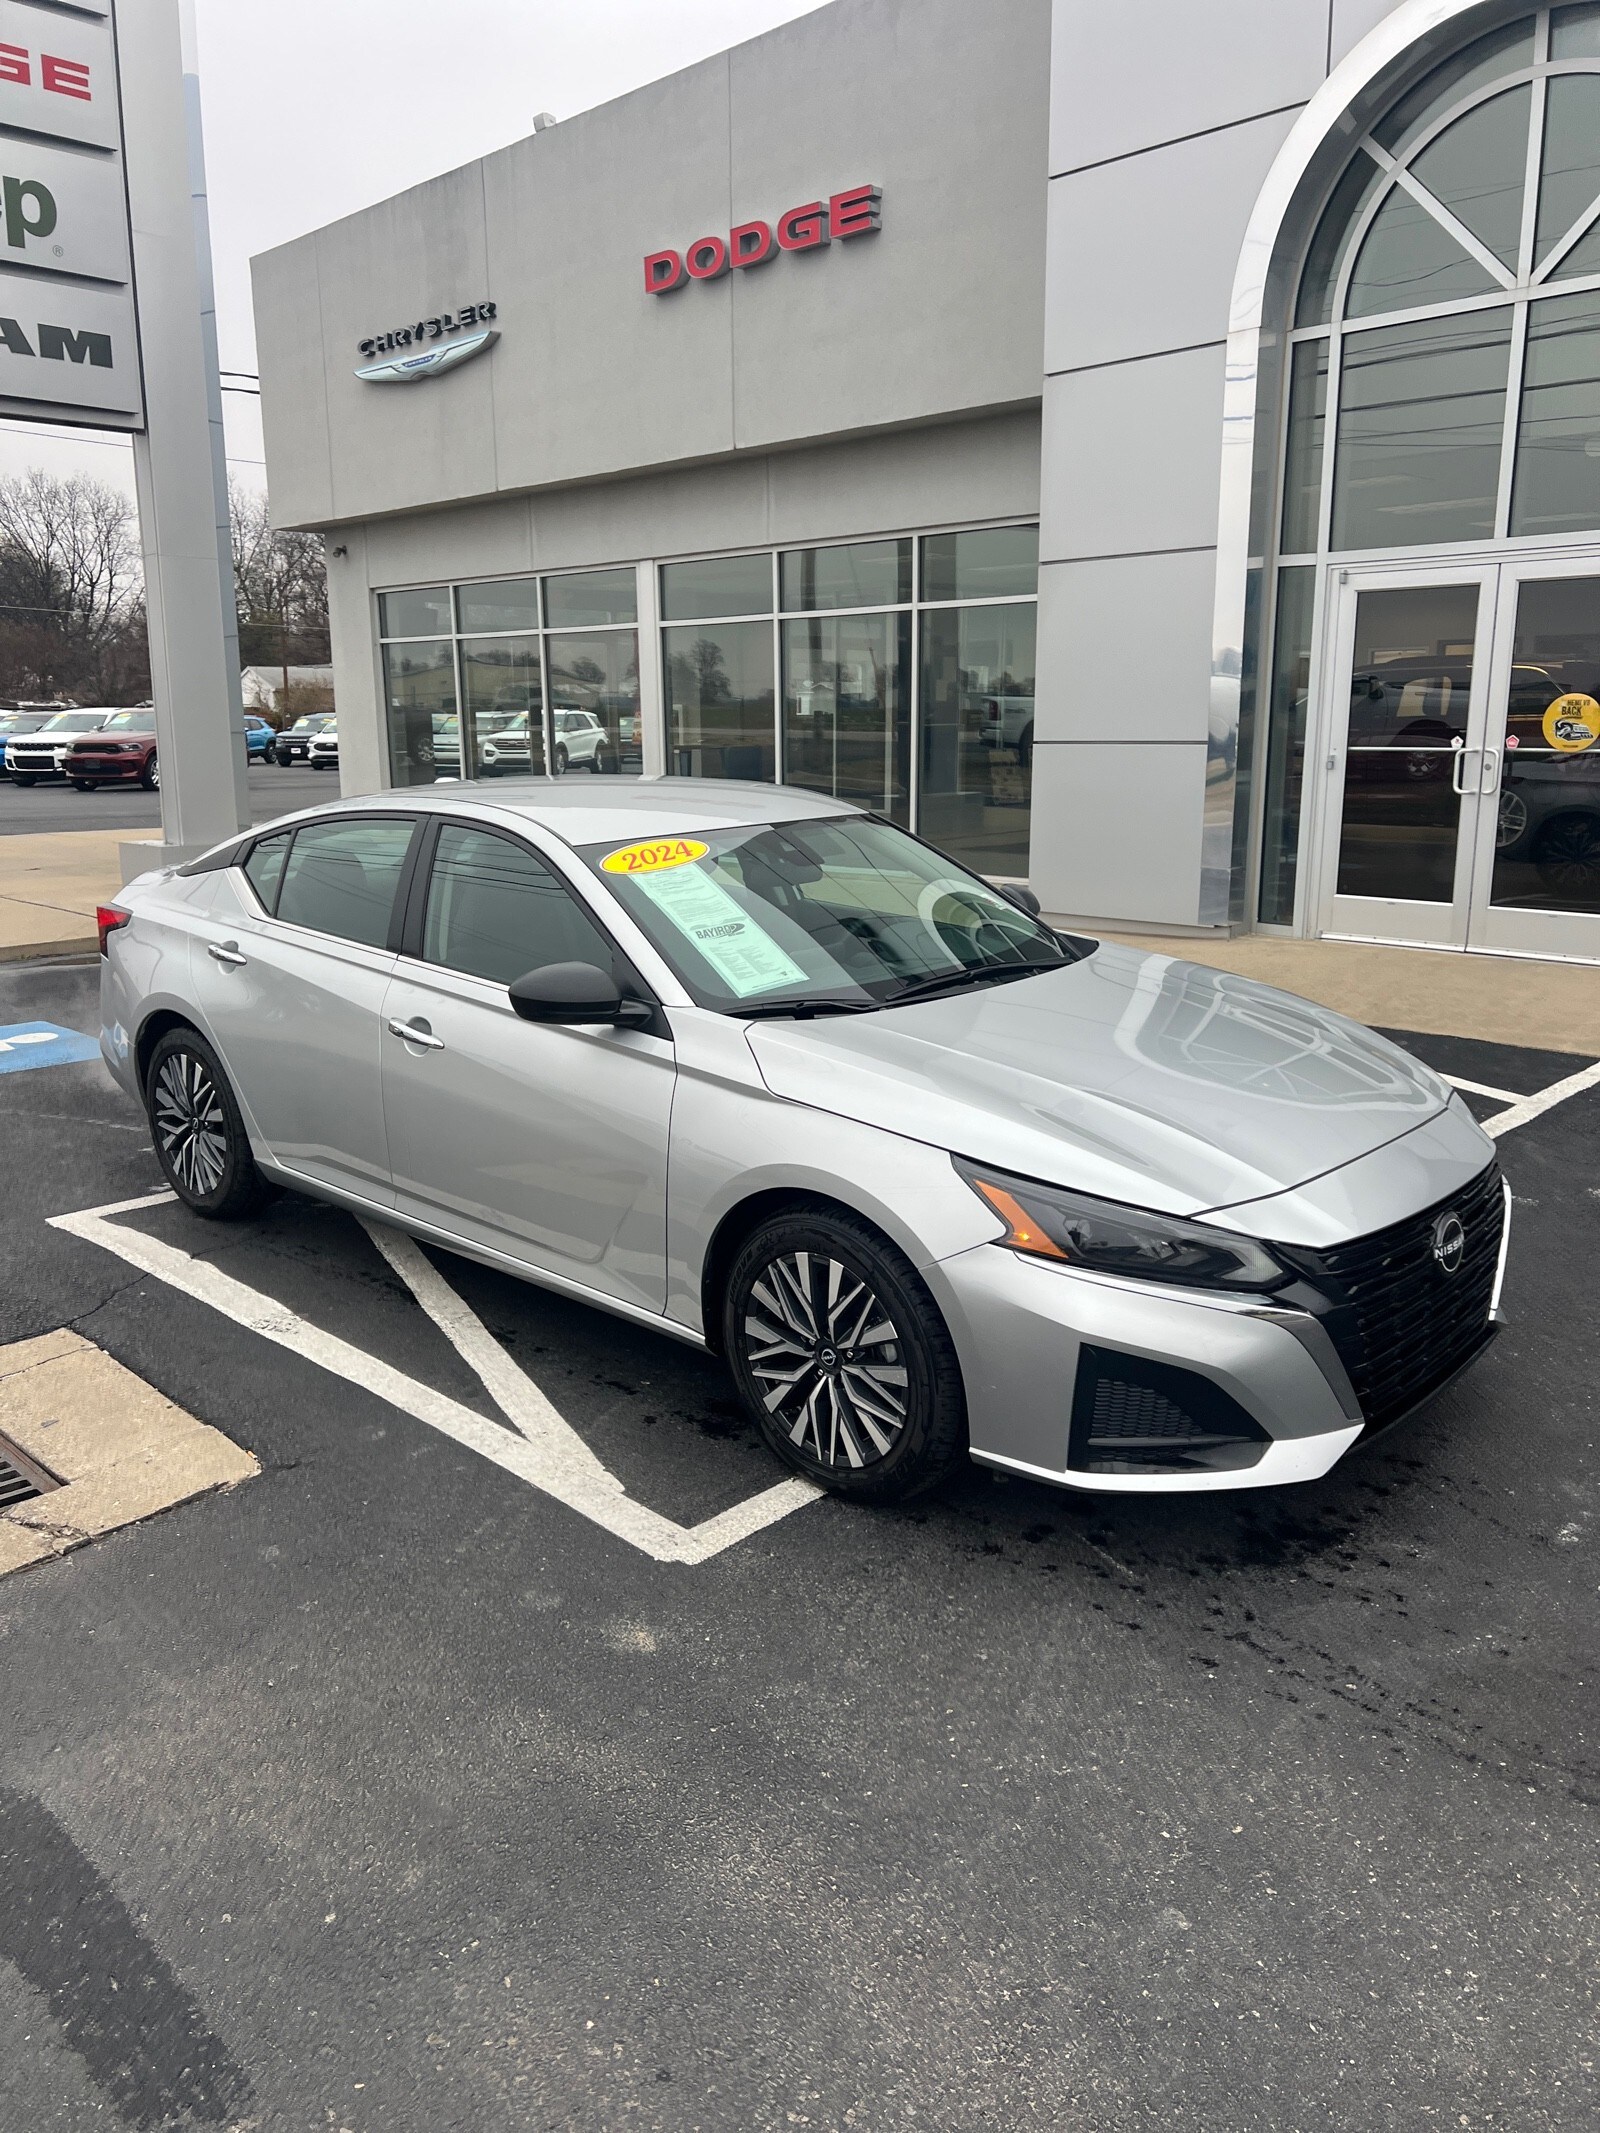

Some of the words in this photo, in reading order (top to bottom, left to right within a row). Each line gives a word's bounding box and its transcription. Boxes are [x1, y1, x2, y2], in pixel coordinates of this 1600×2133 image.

[0, 175, 57, 249] p
[643, 184, 883, 296] DODGE
[357, 300, 497, 358] CHRYSLER
[1561, 706, 1582, 716] BACK
[622, 841, 694, 871] 2024
[1434, 1236, 1463, 1259] NISSA
